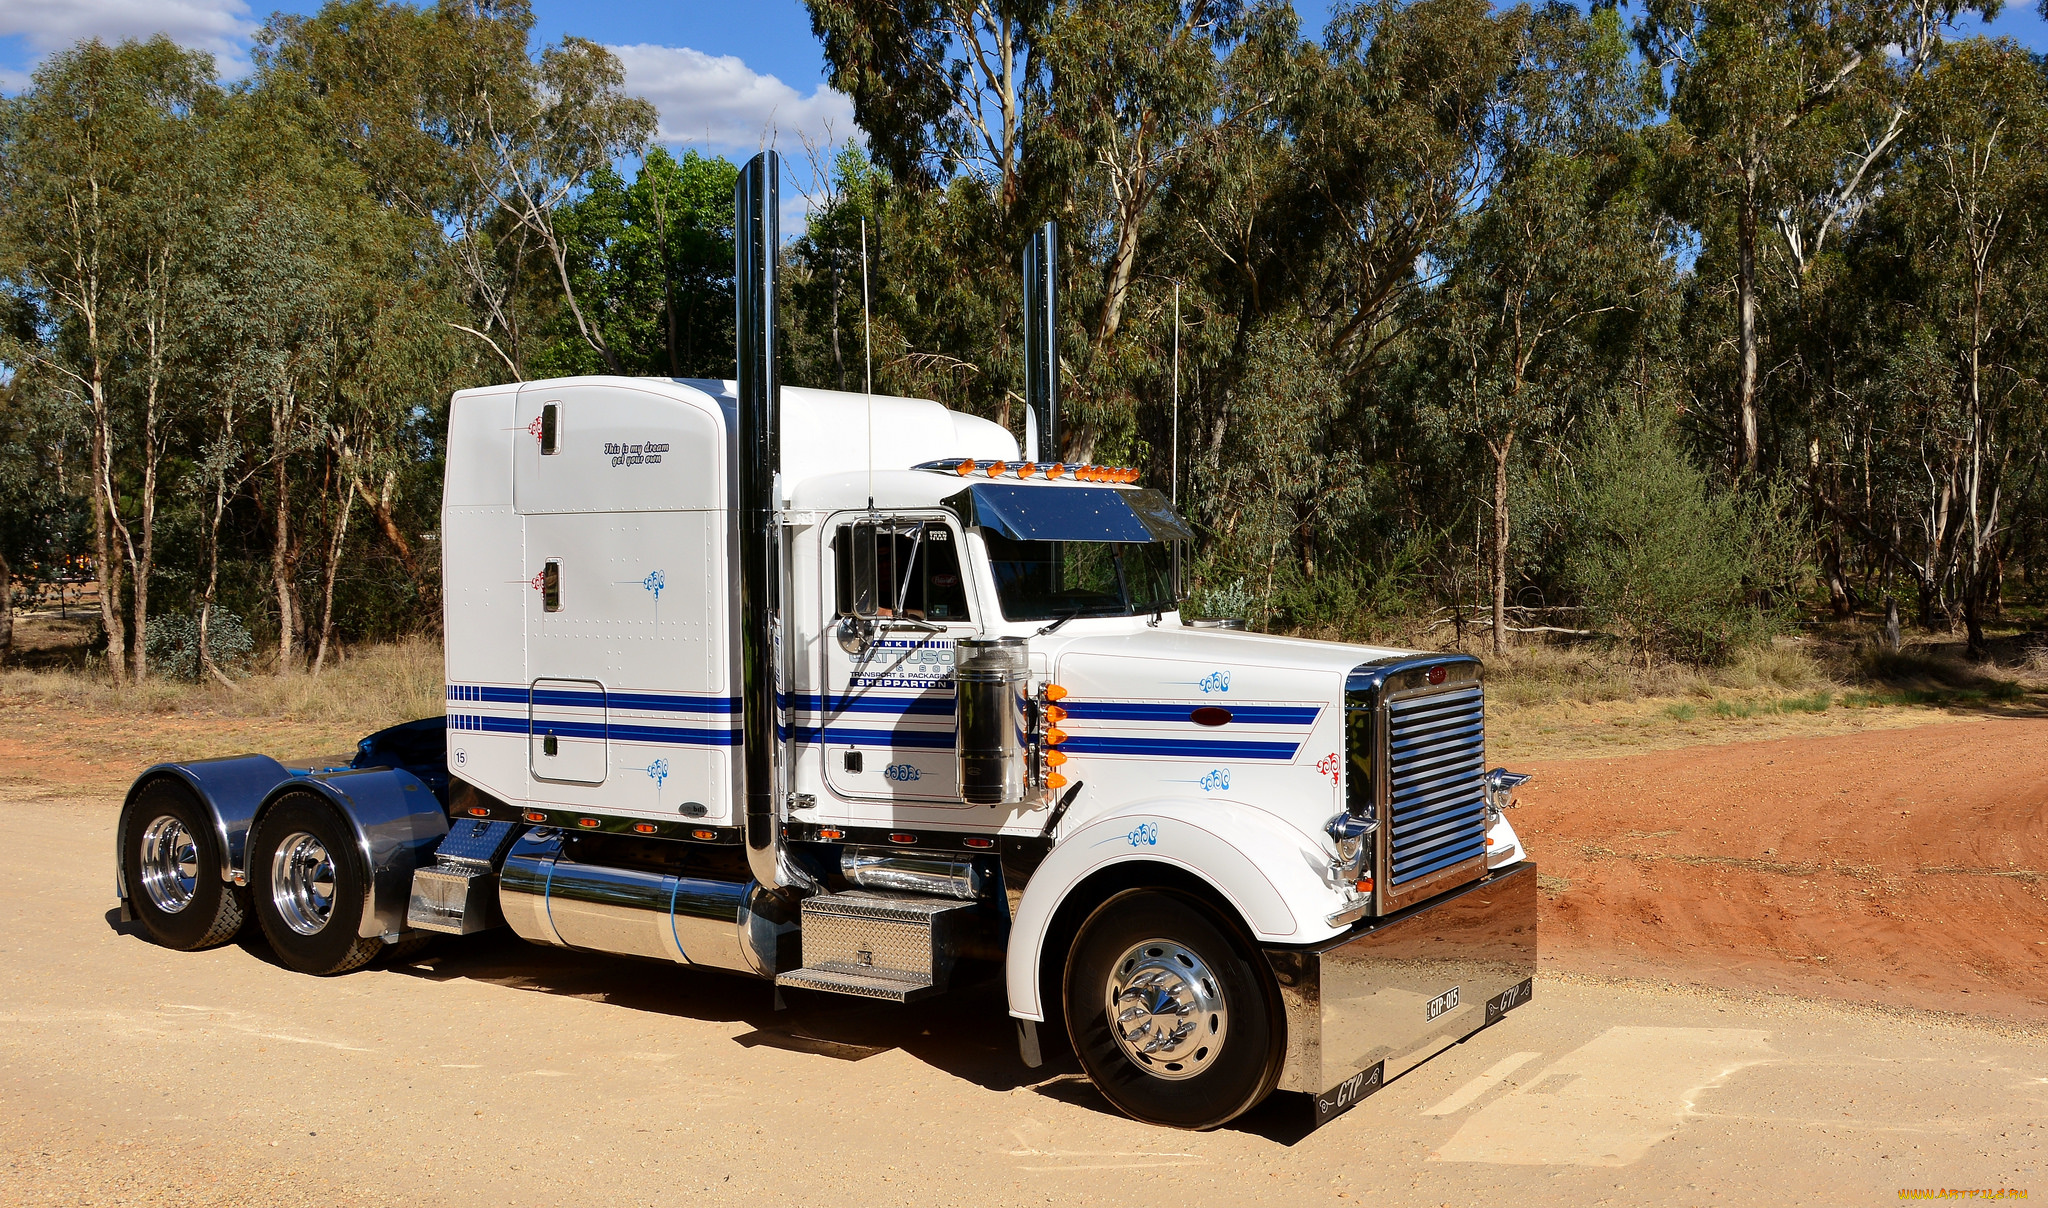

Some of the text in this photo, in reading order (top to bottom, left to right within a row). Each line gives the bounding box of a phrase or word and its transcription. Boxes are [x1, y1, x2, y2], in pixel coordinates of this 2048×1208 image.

[604, 441, 669, 455] This is my dream
[612, 454, 661, 467] get your own
[857, 679, 947, 688] SHEPPARTON
[456, 752, 465, 763] 15
[1500, 985, 1519, 1011] GTP
[1337, 1072, 1363, 1107] GTP
